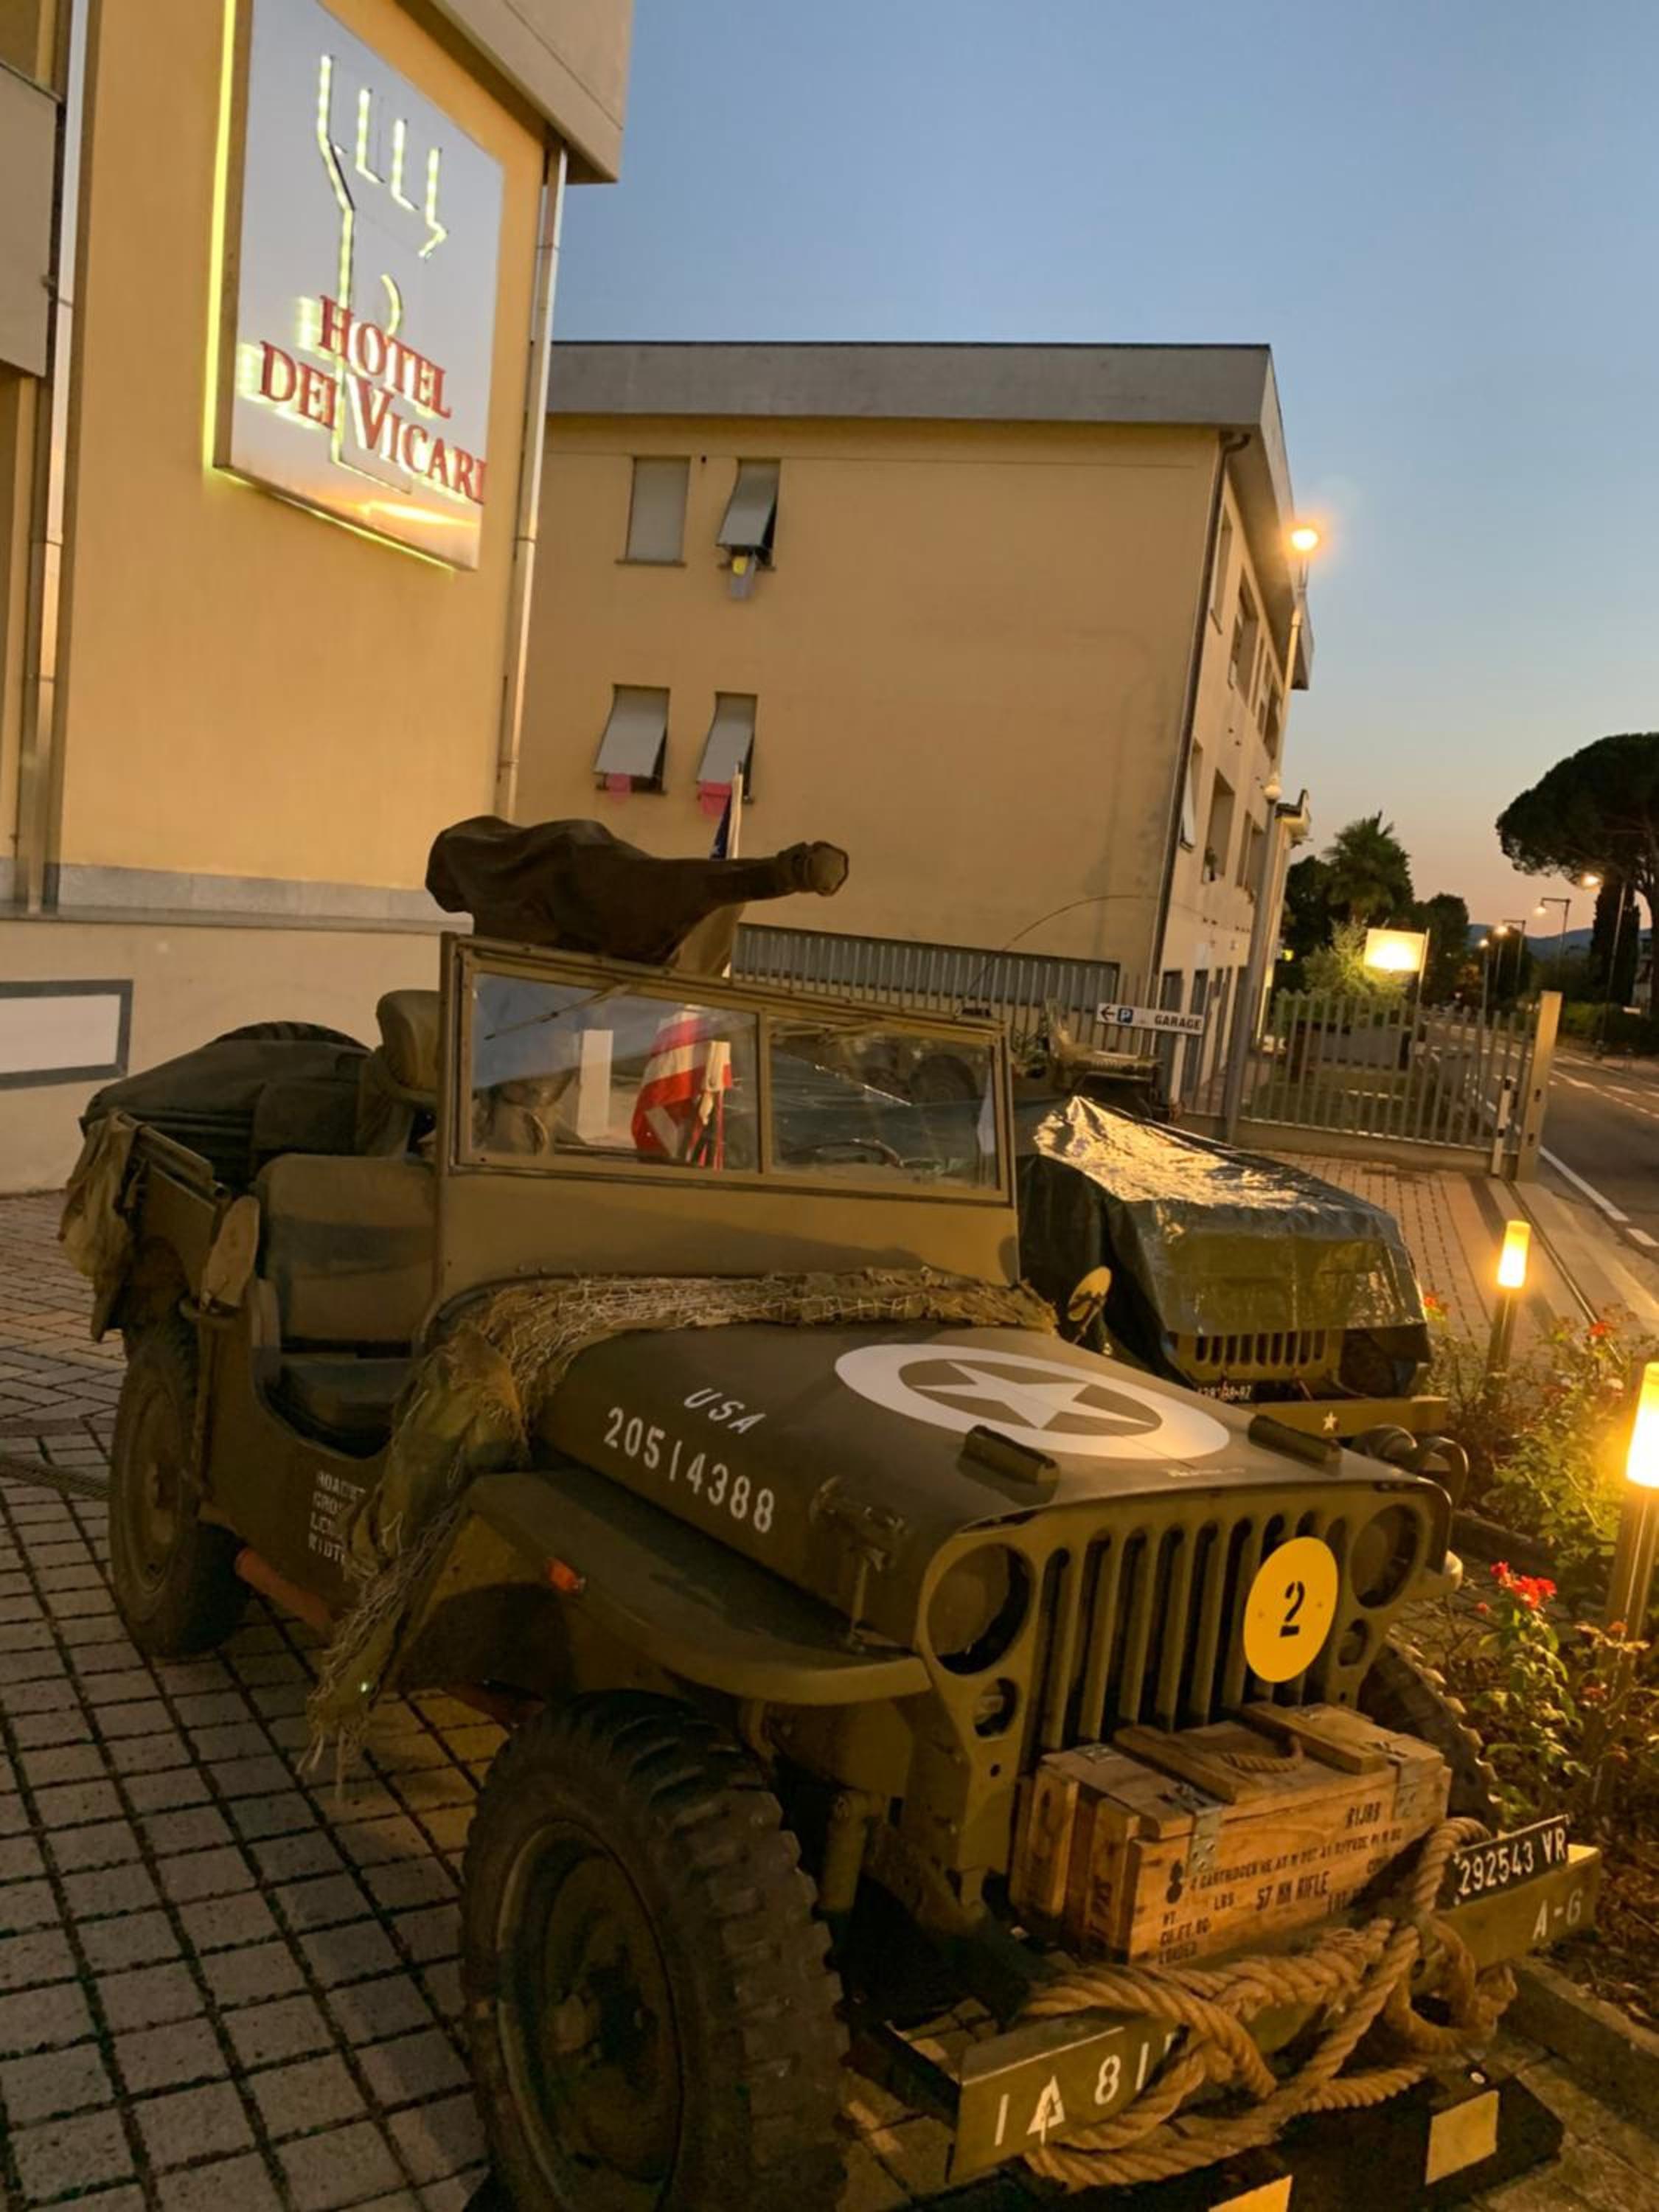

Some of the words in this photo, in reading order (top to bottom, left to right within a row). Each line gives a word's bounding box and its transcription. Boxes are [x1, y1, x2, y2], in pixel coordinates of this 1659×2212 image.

[318, 295, 451, 419] HOTEL
[260, 341, 339, 431] DEI
[352, 378, 488, 505] VICARI
[1155, 1015, 1202, 1030] GARAGE
[684, 1388, 766, 1434] USA
[604, 1406, 774, 1533] 20514388
[1279, 1581, 1305, 1638] 2
[1459, 1841, 1534, 1896] 292543
[1542, 1826, 1566, 1864] VR
